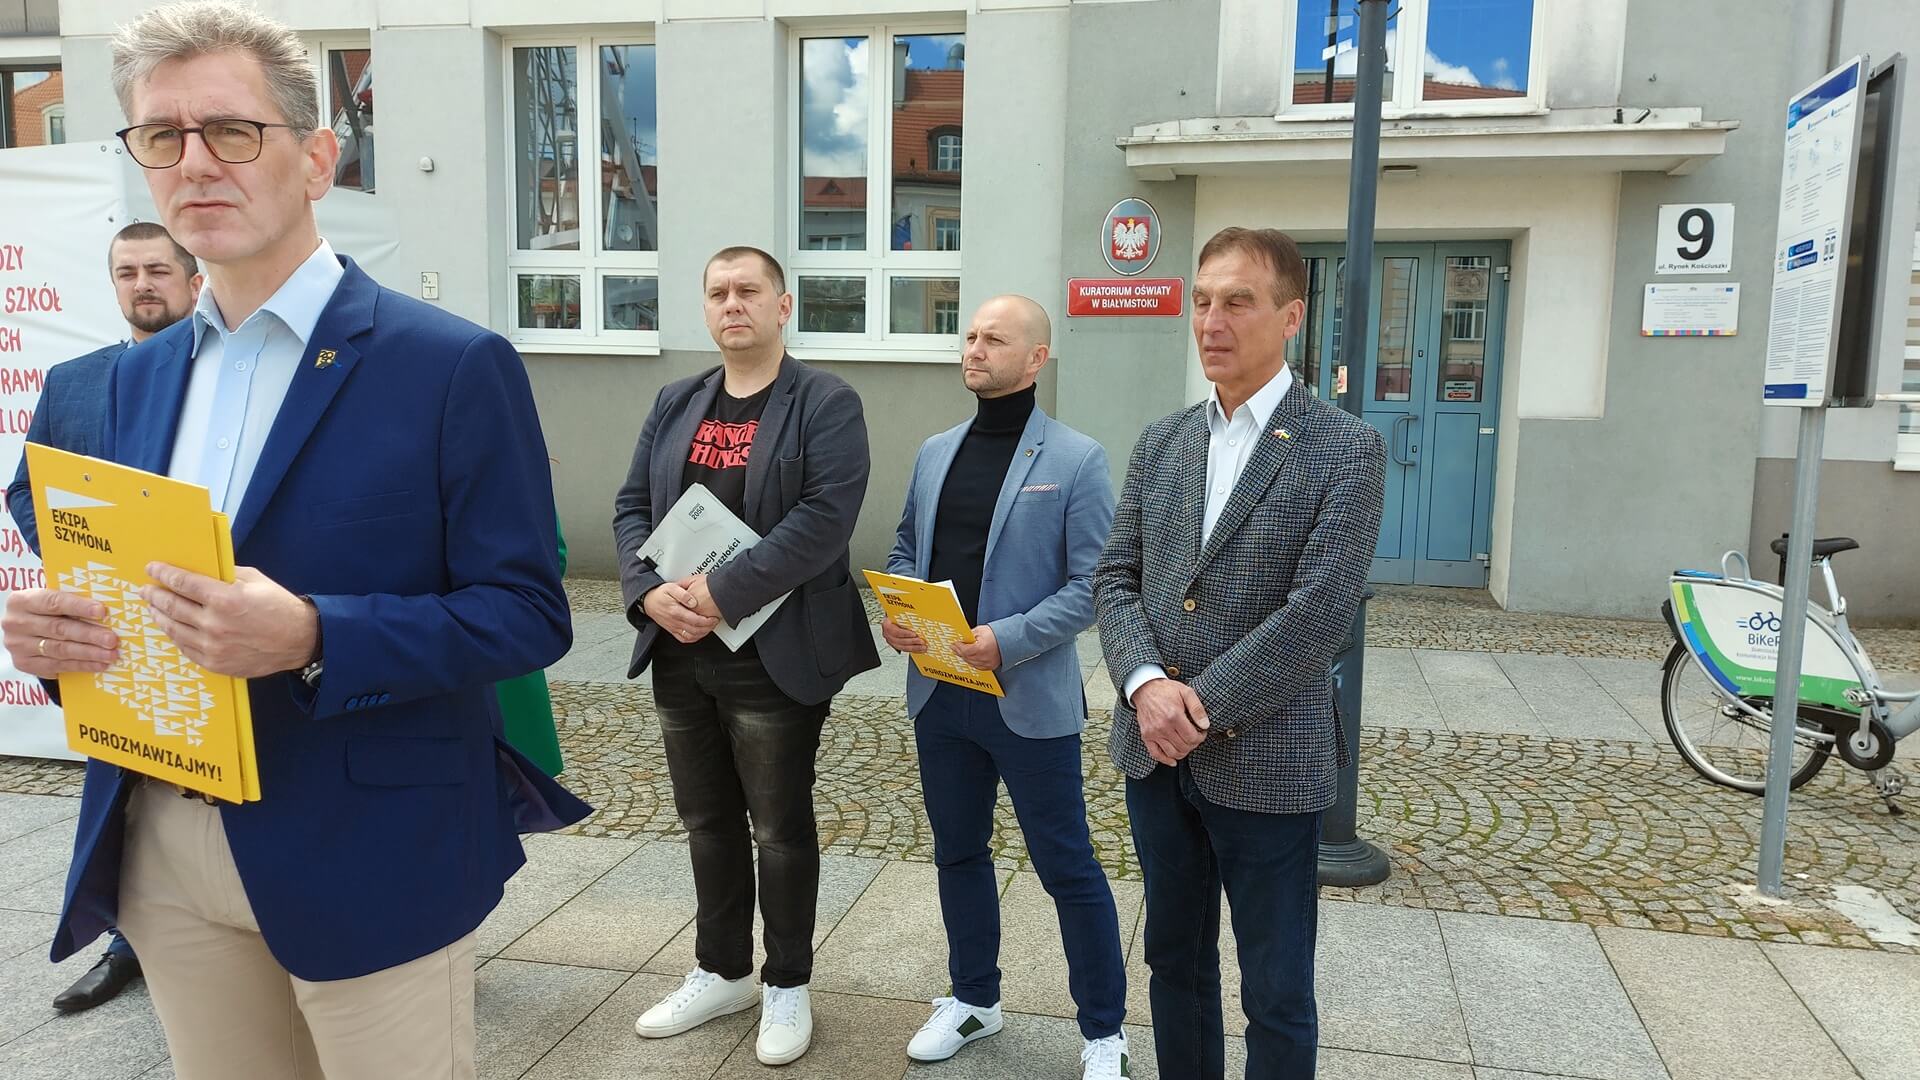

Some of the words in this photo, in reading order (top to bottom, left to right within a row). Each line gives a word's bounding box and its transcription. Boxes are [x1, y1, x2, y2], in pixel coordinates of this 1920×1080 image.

[1677, 207, 1715, 261] 9
[4, 281, 63, 313] SZKÓŁ
[1079, 286, 1132, 297] KURATORIUM
[1134, 284, 1172, 296] OŚWIATY
[1091, 299, 1100, 309] W
[1101, 298, 1159, 308] BIAŁYMSTOKU
[51, 508, 90, 532] EKIPA
[691, 505, 705, 520] 2050
[54, 525, 113, 555] SZYMONA
[690, 550, 717, 577] ukacja
[79, 723, 223, 782] POROZMAWIAJMY!
